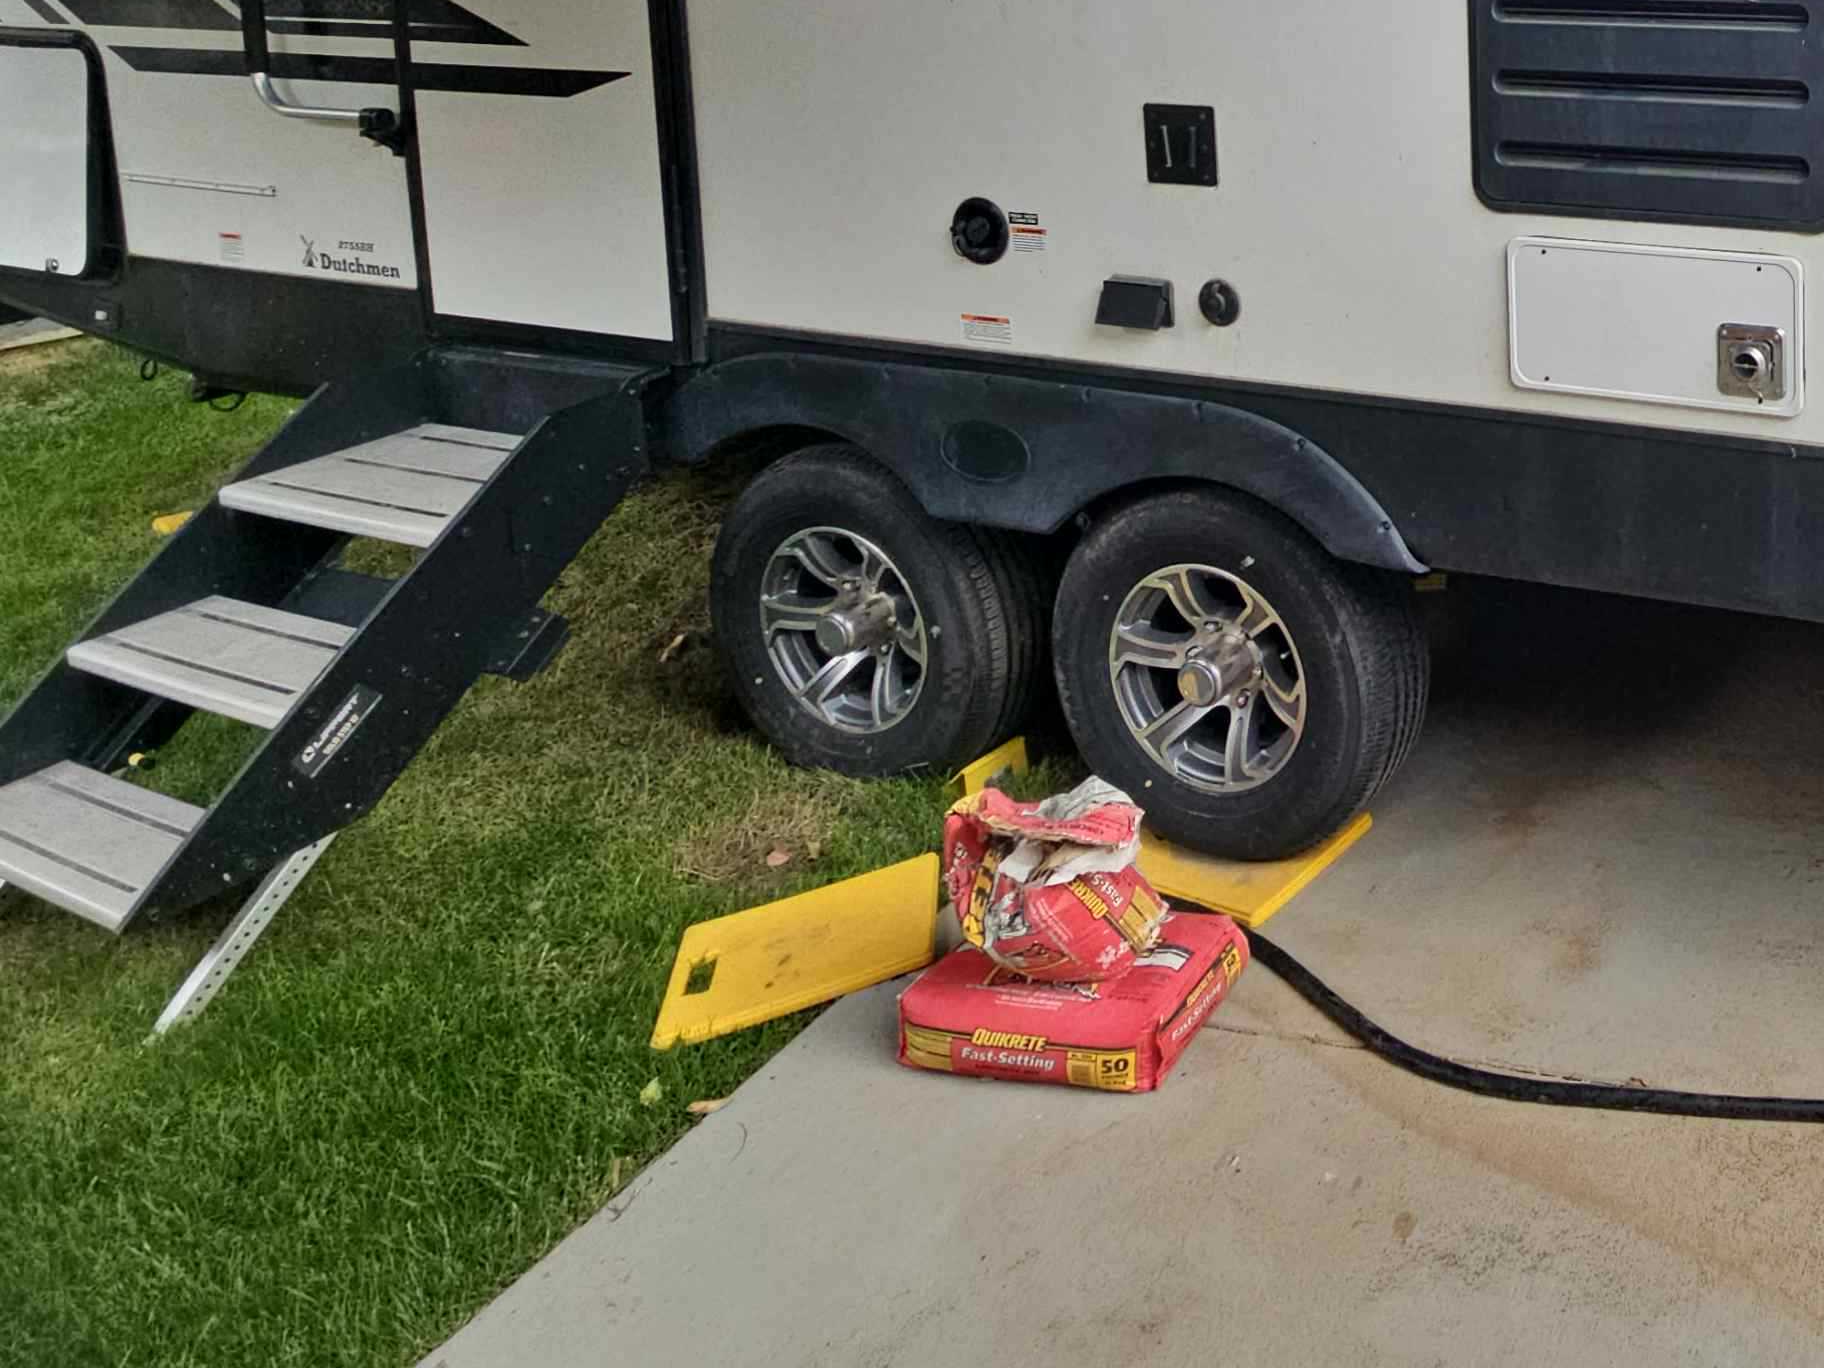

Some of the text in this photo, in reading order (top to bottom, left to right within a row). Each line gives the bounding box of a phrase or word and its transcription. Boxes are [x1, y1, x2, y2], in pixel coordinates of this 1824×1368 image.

[319, 252, 401, 280] Dutchmen
[1071, 879, 1109, 920] QUIKRE
[971, 1027, 1048, 1052] QUIKRETE
[1101, 1058, 1129, 1074] 50
